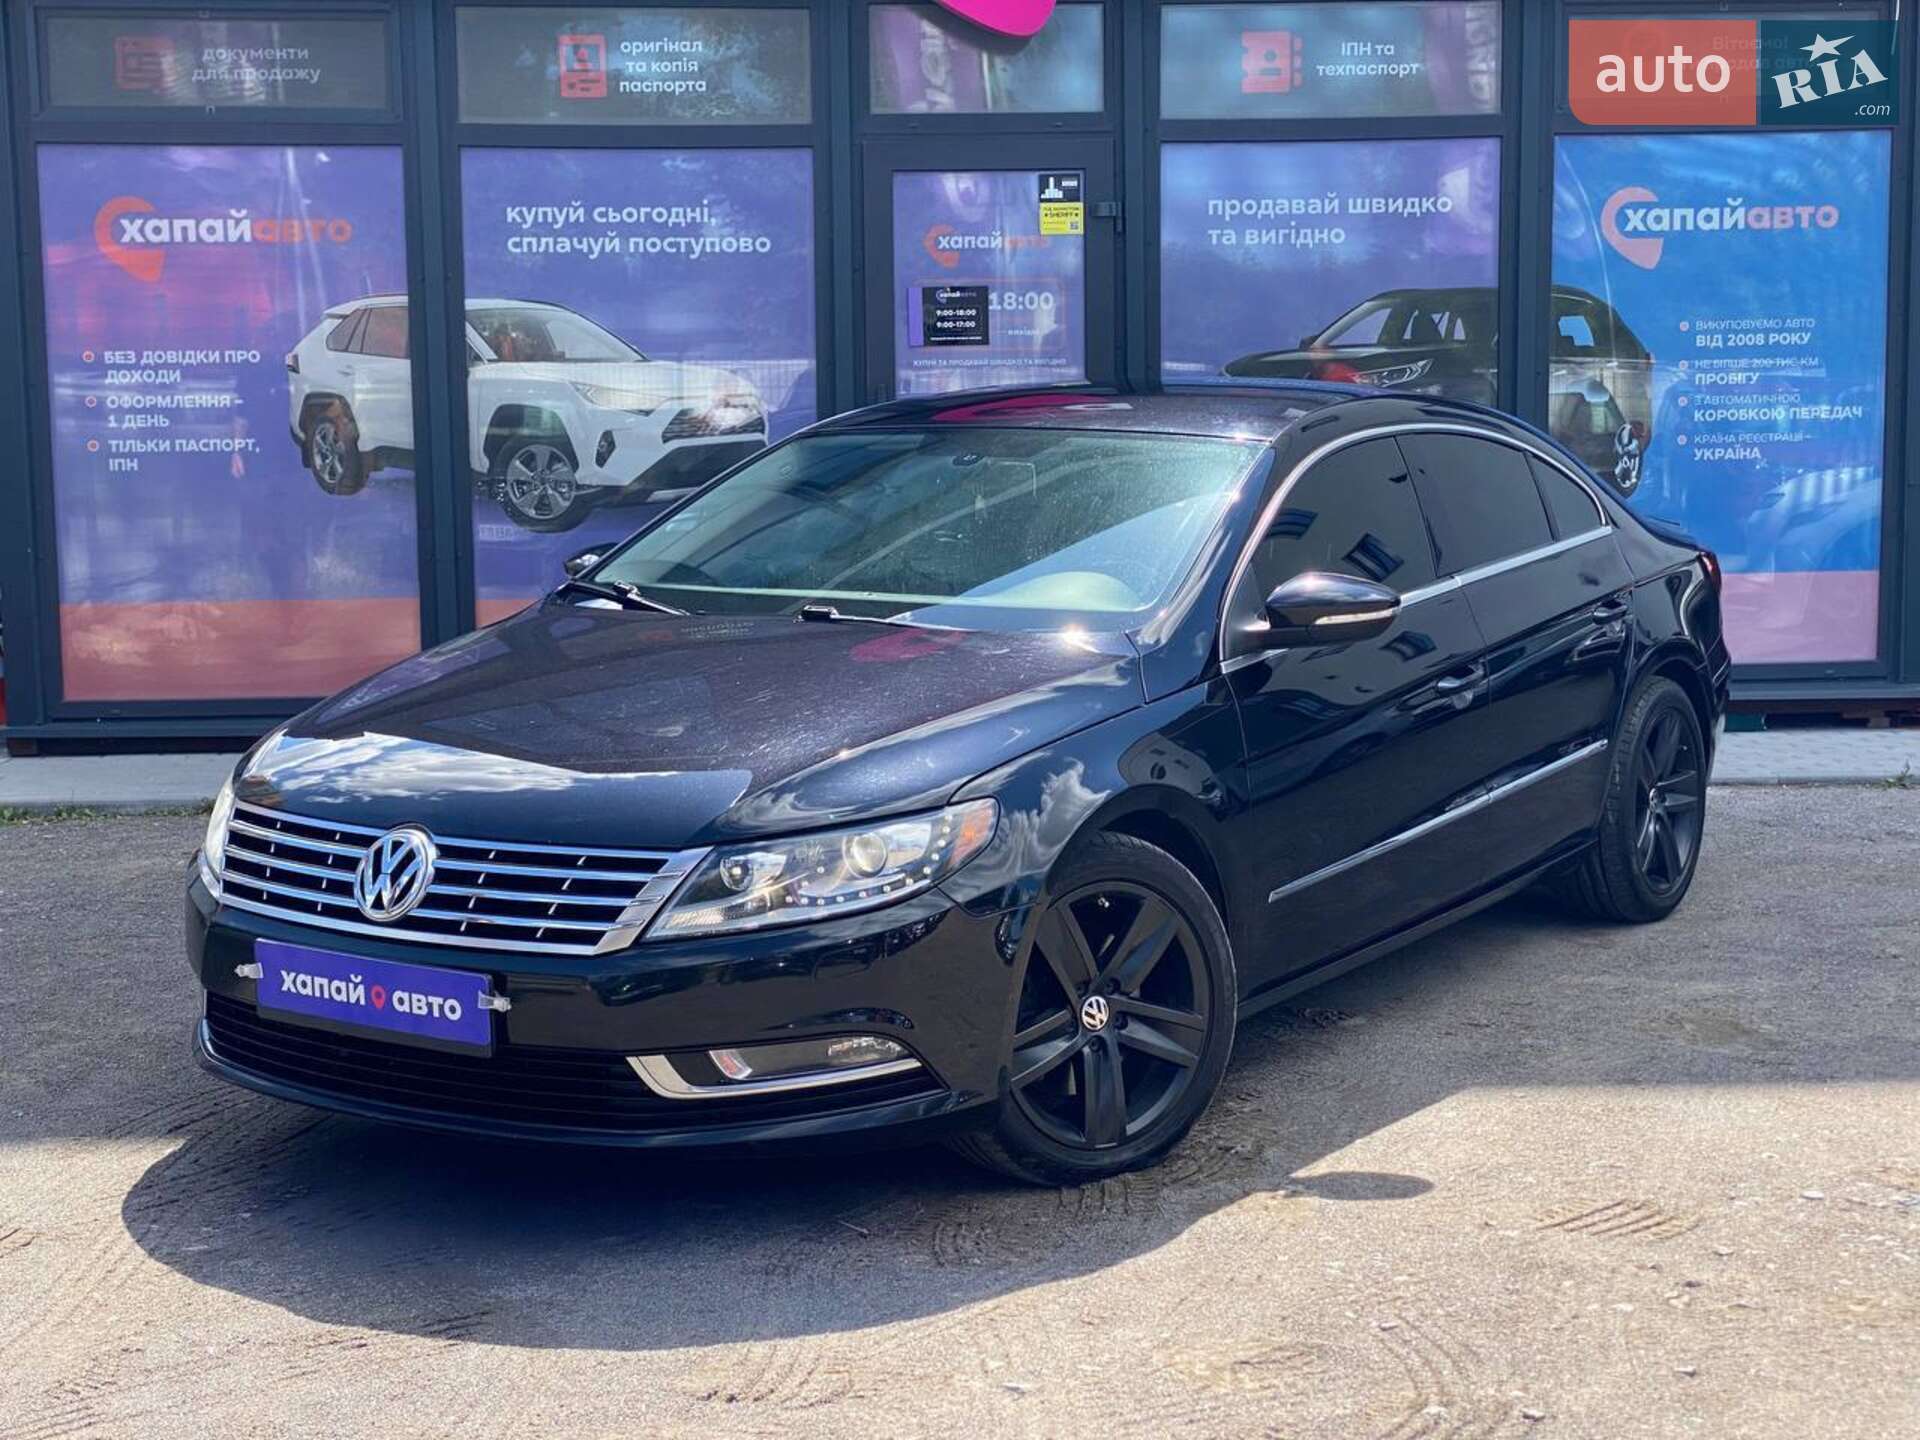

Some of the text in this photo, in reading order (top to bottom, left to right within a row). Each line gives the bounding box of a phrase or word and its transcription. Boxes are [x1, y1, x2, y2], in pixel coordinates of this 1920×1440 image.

[620, 36, 703, 55] оригінал
[1341, 42, 1395, 56] ІПН та
[202, 46, 310, 63] документи
[625, 57, 698, 74] та копія
[1316, 63, 1418, 78] техпаспорт
[192, 67, 230, 82] для
[619, 76, 707, 94] паспорта
[506, 199, 717, 229] купуй сьогодні,
[1207, 193, 1454, 222] продавай швидко
[1207, 220, 1346, 249] та вигідно
[507, 230, 771, 260] сплачуй поступово
[1784, 318, 1815, 329] АВТО
[1696, 332, 1812, 348] ВІД 2008 РОКУ
[104, 350, 261, 366] БЕЗ ДОВІДКИ ПРО
[105, 369, 181, 386] ДОХОДИ
[1695, 372, 1760, 386] ПРОБІГУ
[106, 394, 231, 410] ОФОРМЛЕННЯ
[121, 414, 169, 430] ДЕНЬ
[1694, 405, 1863, 422] КОРОБКОЮ ПЕРЕДАЧ
[107, 437, 260, 455] ТІЛЬКИ ПАСПОРТ,
[1694, 444, 1762, 461] УКРАЇНА
[108, 457, 139, 472] ІПН
[281, 969, 463, 1021] хапай авто
